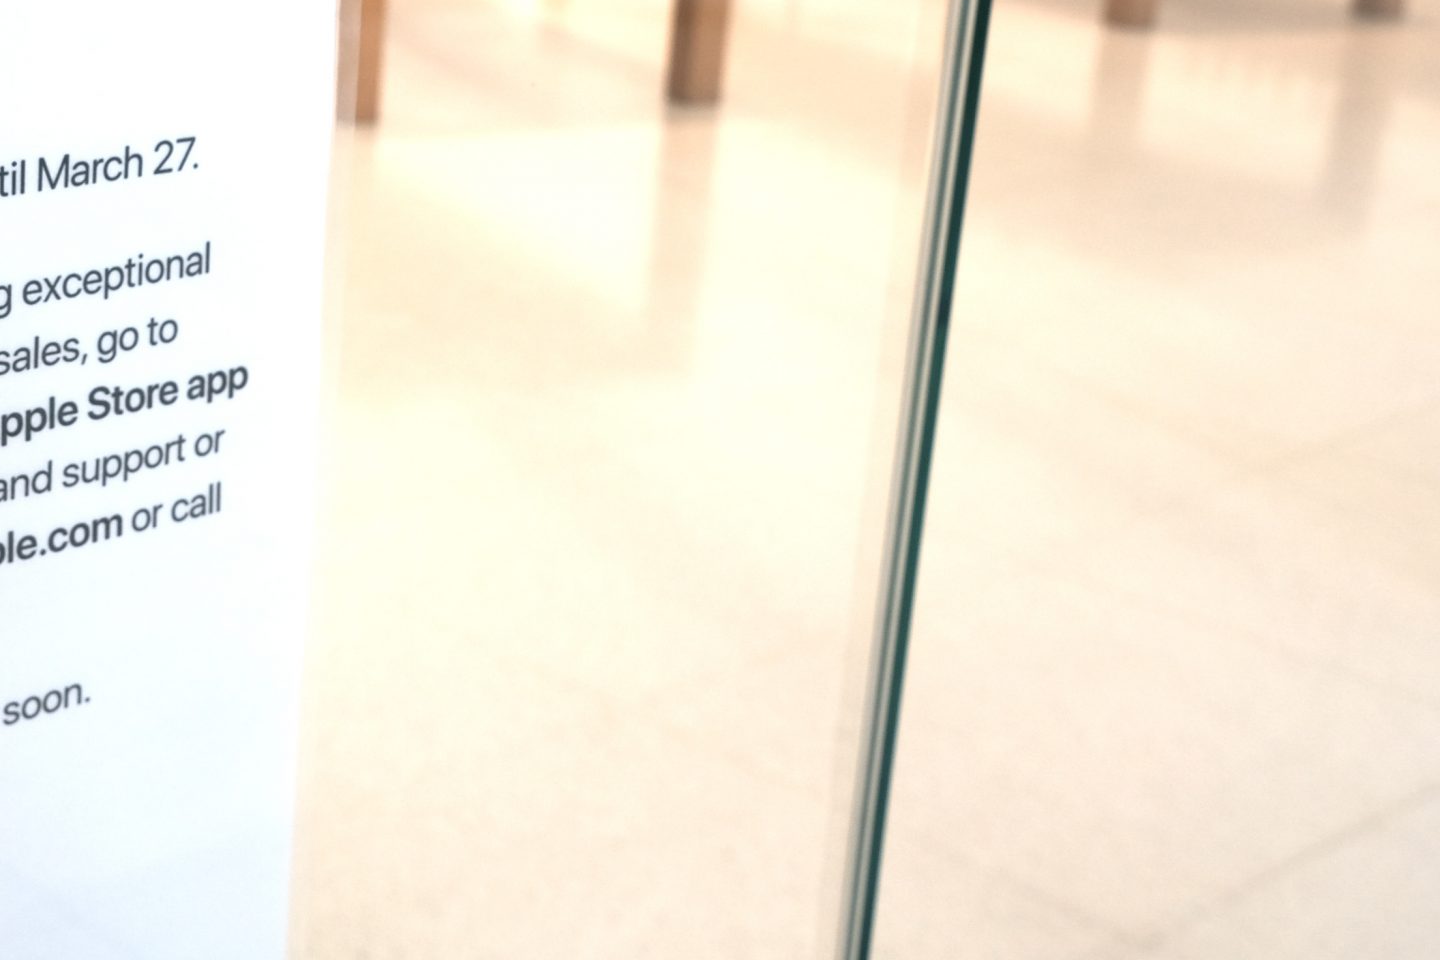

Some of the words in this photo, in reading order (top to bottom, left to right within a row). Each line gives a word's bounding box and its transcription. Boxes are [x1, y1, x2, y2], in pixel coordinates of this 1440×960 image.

[37, 145, 144, 193] March
[152, 136, 199, 176] 27.
[21, 240, 211, 306] exceptional
[96, 326, 140, 364] go
[146, 316, 179, 347] to
[87, 380, 180, 421] Store
[186, 365, 249, 404] app
[61, 434, 187, 489] support
[193, 429, 226, 458] or
[130, 503, 164, 533] or
[170, 481, 222, 523] call
[2, 683, 91, 726] soon.
